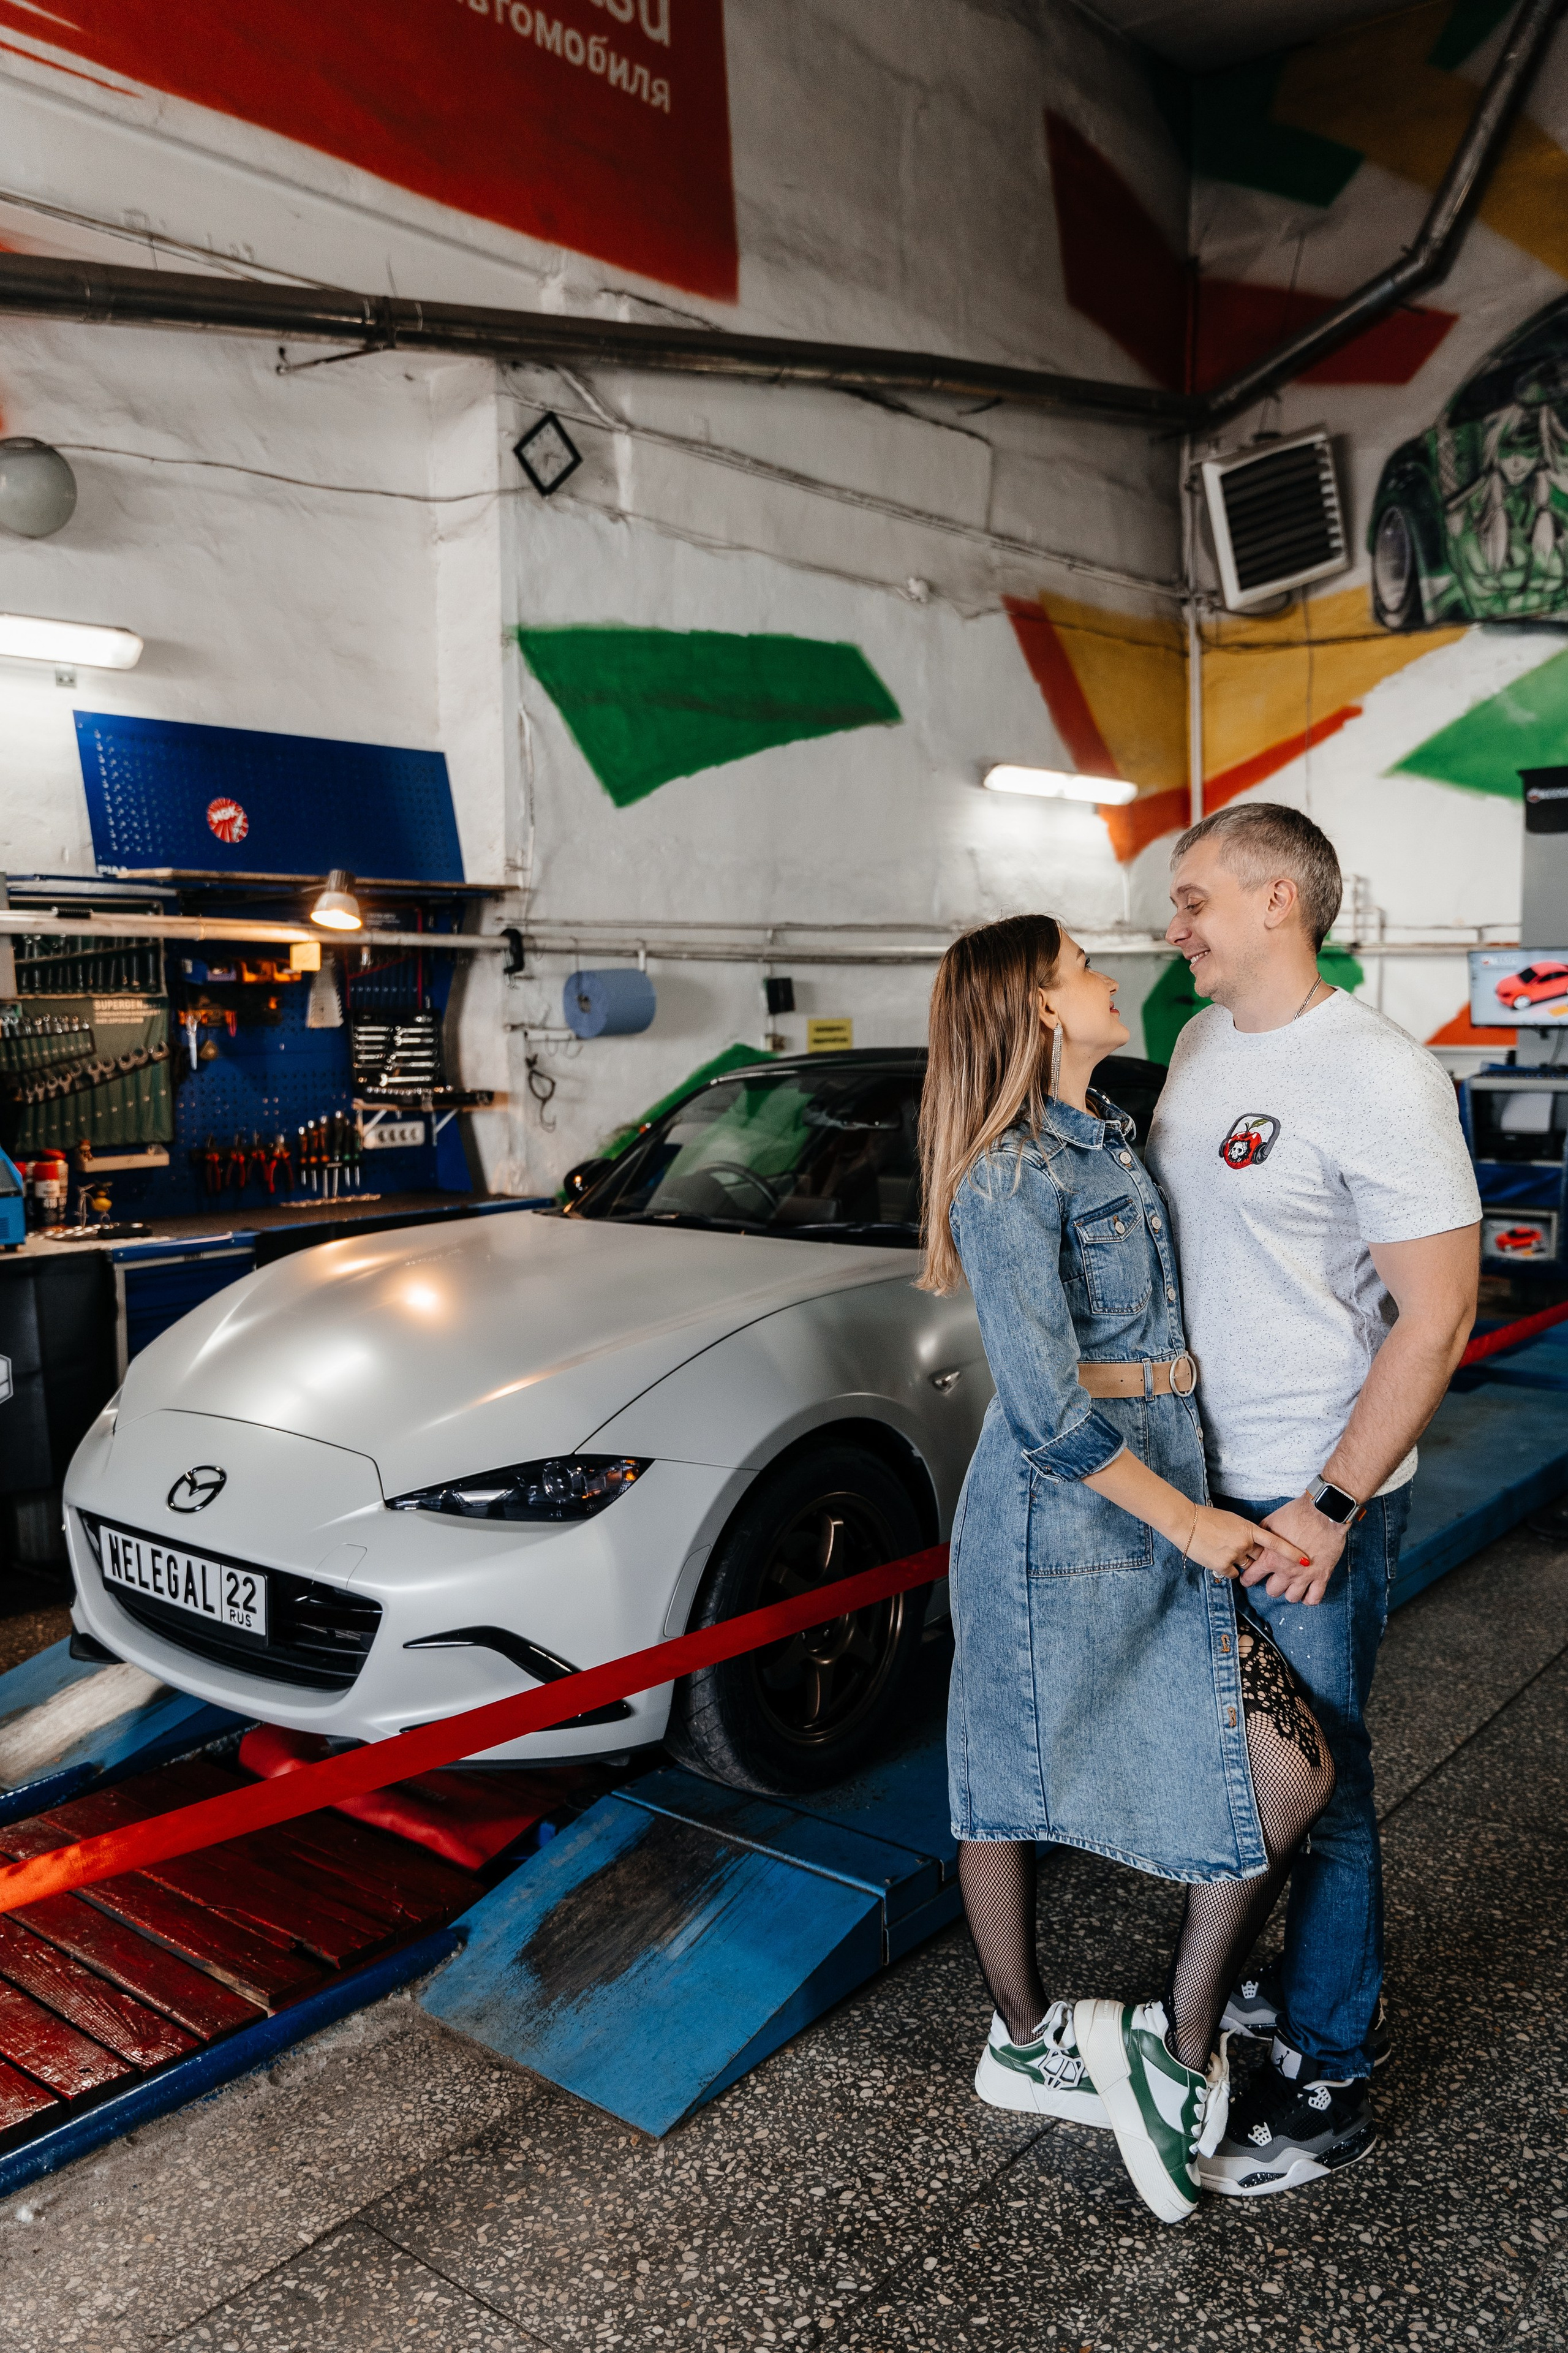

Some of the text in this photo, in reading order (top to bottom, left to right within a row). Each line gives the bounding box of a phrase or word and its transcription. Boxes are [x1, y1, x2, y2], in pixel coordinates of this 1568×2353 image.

[108, 1533, 257, 1614] NELEGAL 22
[230, 1609, 252, 1628] RUS
